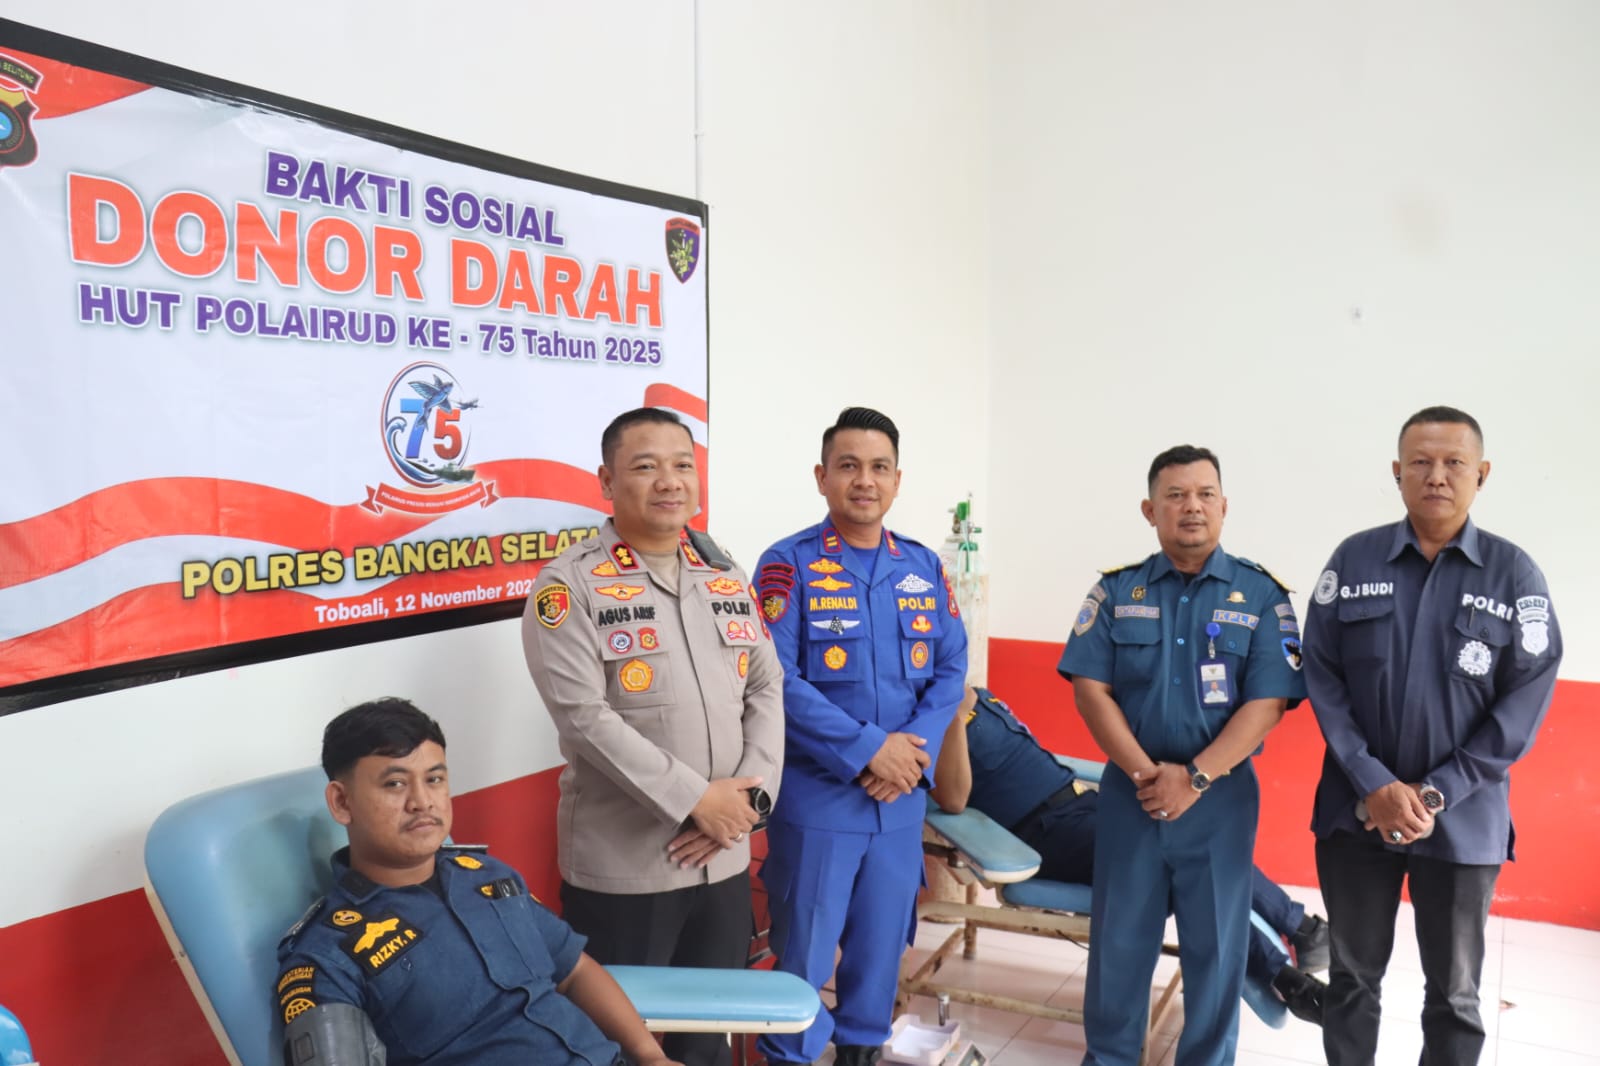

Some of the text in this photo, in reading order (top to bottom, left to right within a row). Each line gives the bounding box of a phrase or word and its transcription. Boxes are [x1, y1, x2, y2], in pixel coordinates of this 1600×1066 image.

[265, 151, 564, 246] BAKTI SOSIAL
[69, 174, 662, 327] DONOR DARAH
[80, 284, 180, 328] HUT
[197, 297, 396, 344] POLAIRUD
[408, 317, 450, 349] KE
[479, 324, 516, 353] 75
[522, 328, 597, 360] Tahun
[605, 337, 661, 364] 2025
[182, 550, 345, 599] POLRES
[354, 537, 494, 580] BANGKA
[314, 597, 389, 623] Toboali,
[395, 594, 416, 613] 12
[421, 585, 502, 609] November
[506, 577, 537, 597] 202
[1362, 582, 1393, 596] BUDI
[711, 601, 750, 616] POLRI
[809, 596, 858, 611] M.RENALDI
[898, 597, 936, 611] POLRI
[1462, 593, 1514, 621] POLRI
[598, 608, 631, 626] AGUS
[404, 929, 417, 940] R
